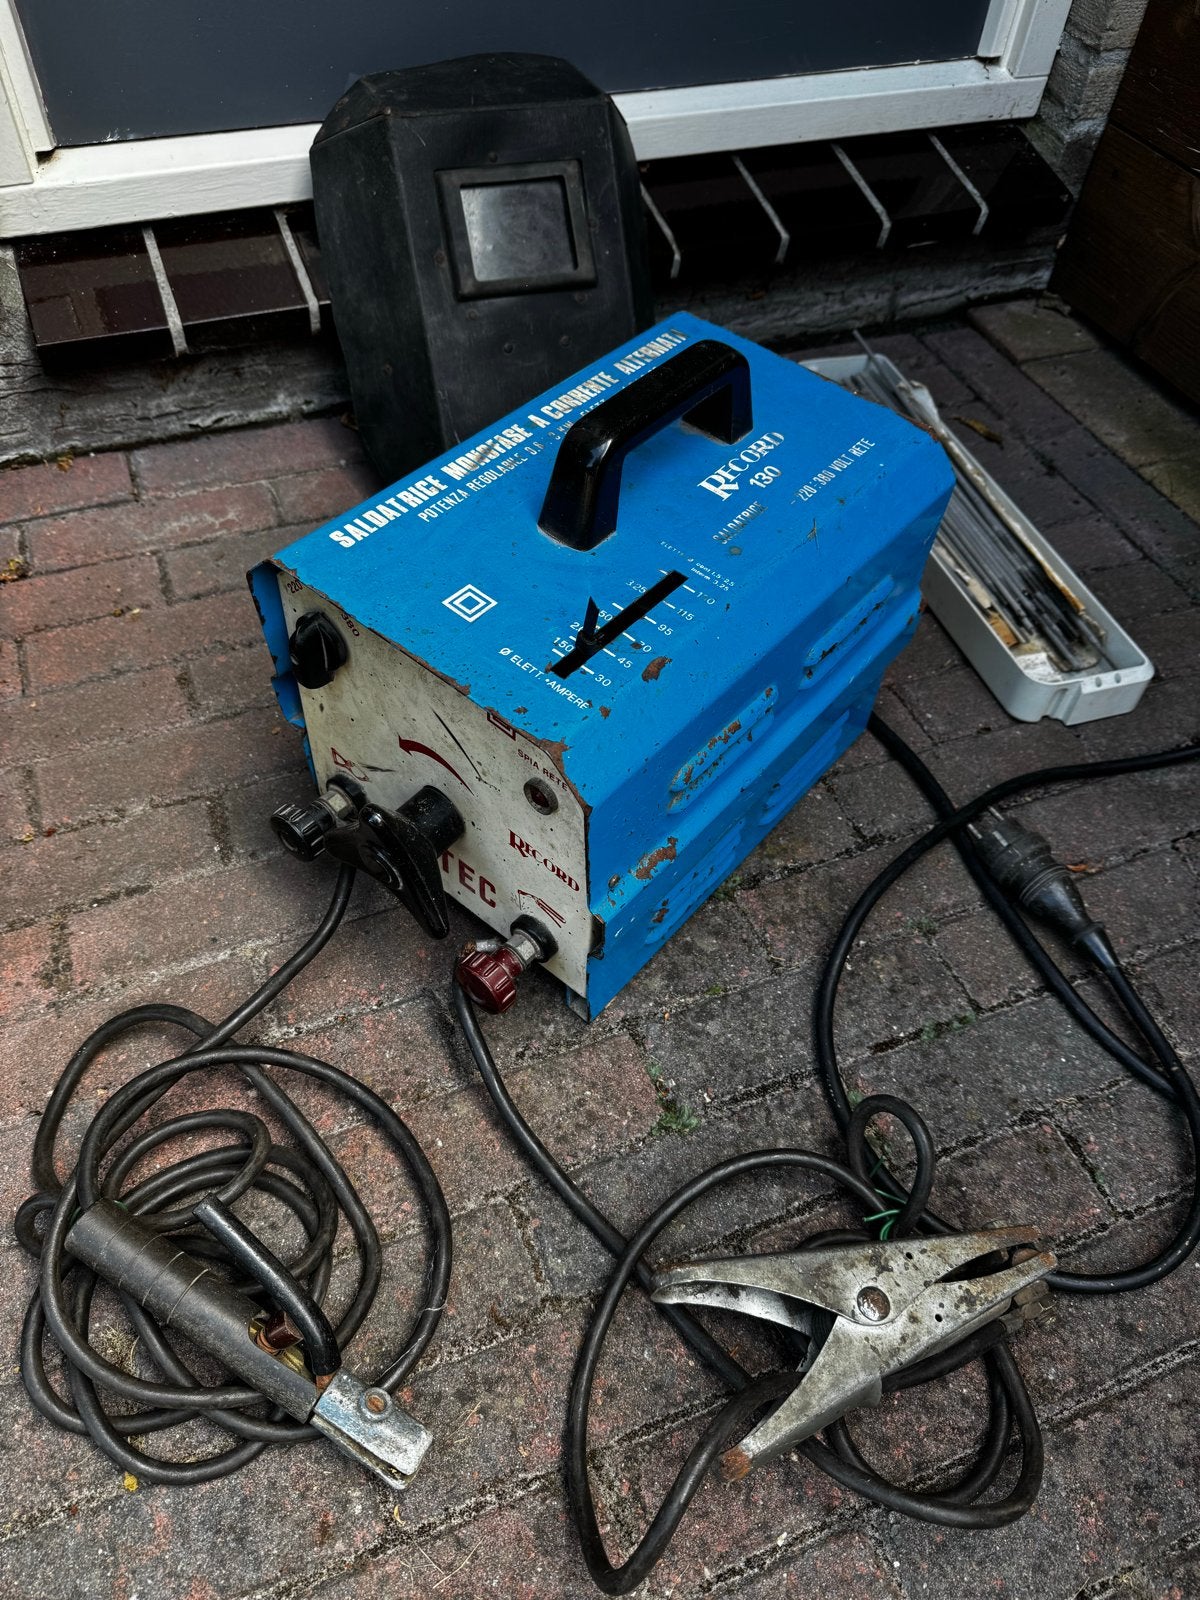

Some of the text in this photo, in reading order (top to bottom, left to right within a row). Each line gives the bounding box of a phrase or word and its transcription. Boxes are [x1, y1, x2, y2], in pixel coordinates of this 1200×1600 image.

[329, 474, 449, 548] SALDATRICE
[440, 424, 533, 481] MONOFASE
[527, 414, 551, 429] A
[540, 371, 620, 420] CORRENTE
[697, 431, 784, 502] RECORD
[828, 453, 855, 472] VOLT
[848, 437, 876, 457] RETE
[417, 488, 470, 522] POTENZA
[466, 453, 528, 491] REGOLABILE
[750, 465, 782, 488] 130
[712, 501, 768, 545] SALDATRICE
[286, 579, 304, 594] 220
[697, 592, 716, 605] 10
[656, 623, 674, 636] 95
[676, 608, 695, 622] 115
[617, 656, 634, 669] 45
[594, 674, 612, 687] 30
[517, 748, 568, 792] SPIA RETE
[508, 828, 580, 892] RECORD
